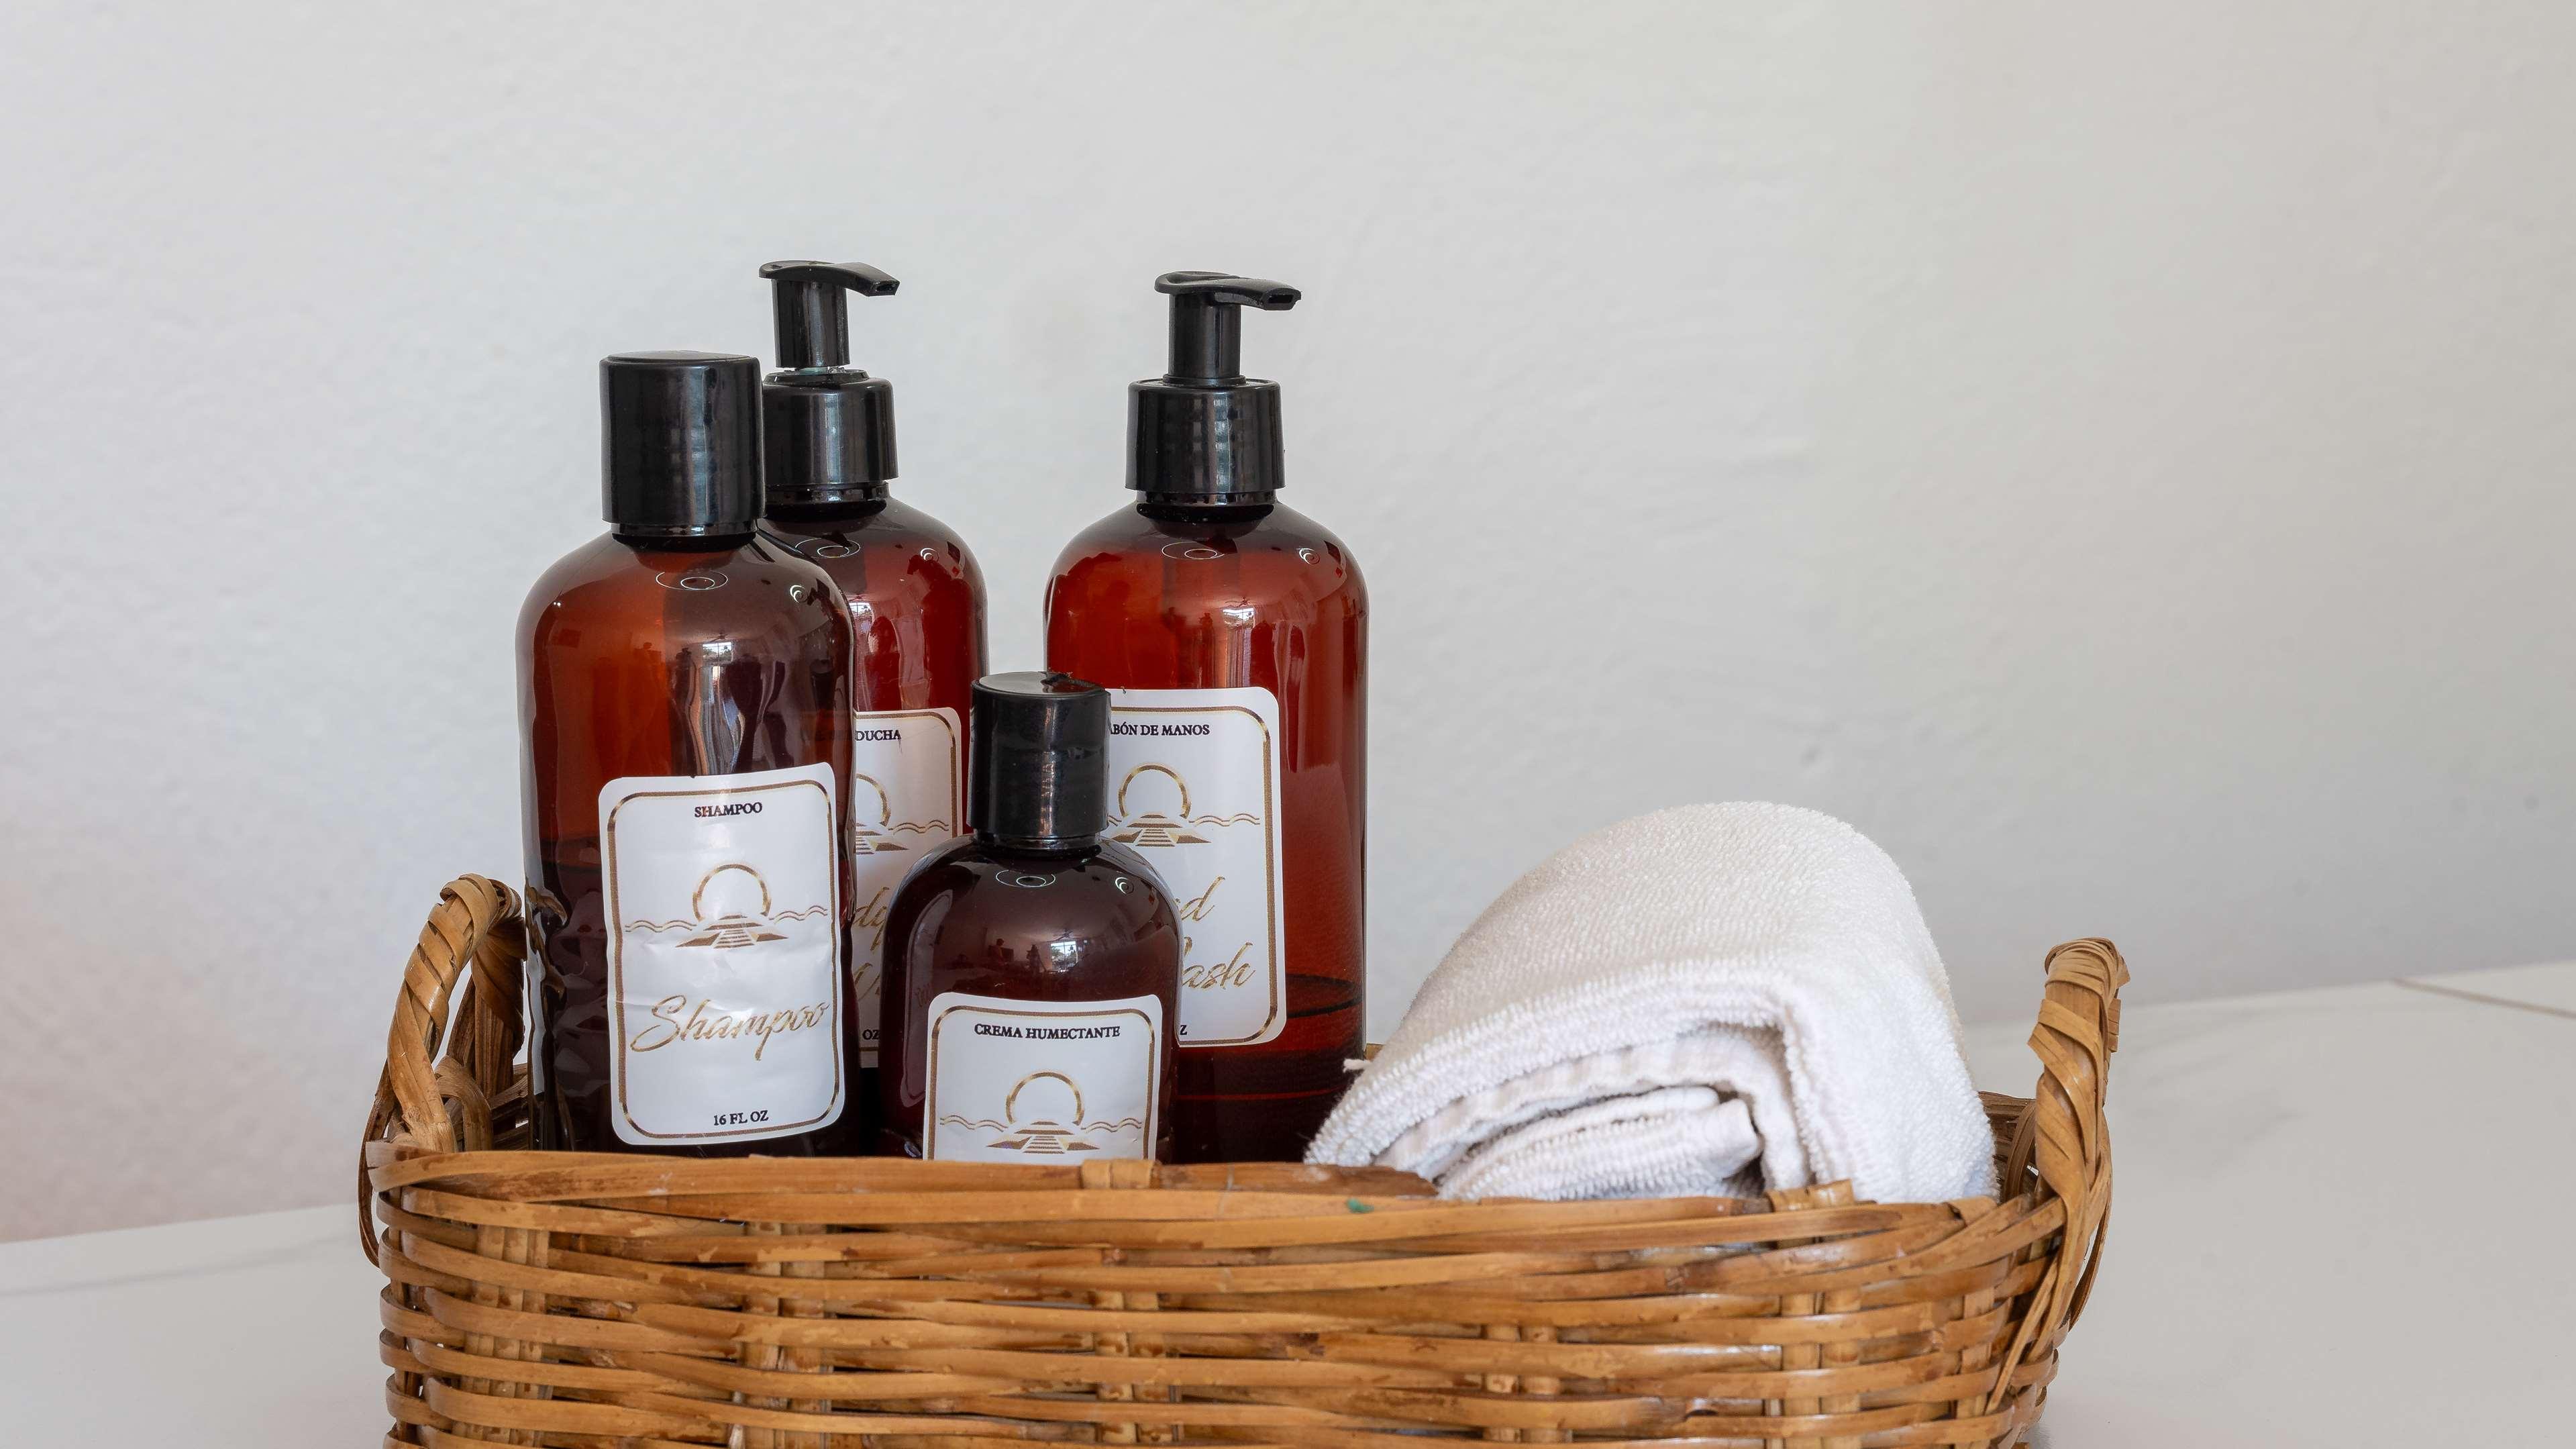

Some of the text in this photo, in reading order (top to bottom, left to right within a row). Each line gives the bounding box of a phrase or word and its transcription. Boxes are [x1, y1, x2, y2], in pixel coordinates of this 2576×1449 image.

[855, 730, 902, 741] DUCHA
[1140, 724, 1159, 736] DE
[1162, 724, 1210, 736] MANOS
[694, 801, 763, 817] SHAMPOO
[1182, 936, 1255, 990] ash
[630, 994, 830, 1061] Shampoo
[862, 1029, 880, 1040] OZ
[974, 1023, 1121, 1040] CREMA HUMECTANTE
[713, 1109, 769, 1126] 16 FL OZ
